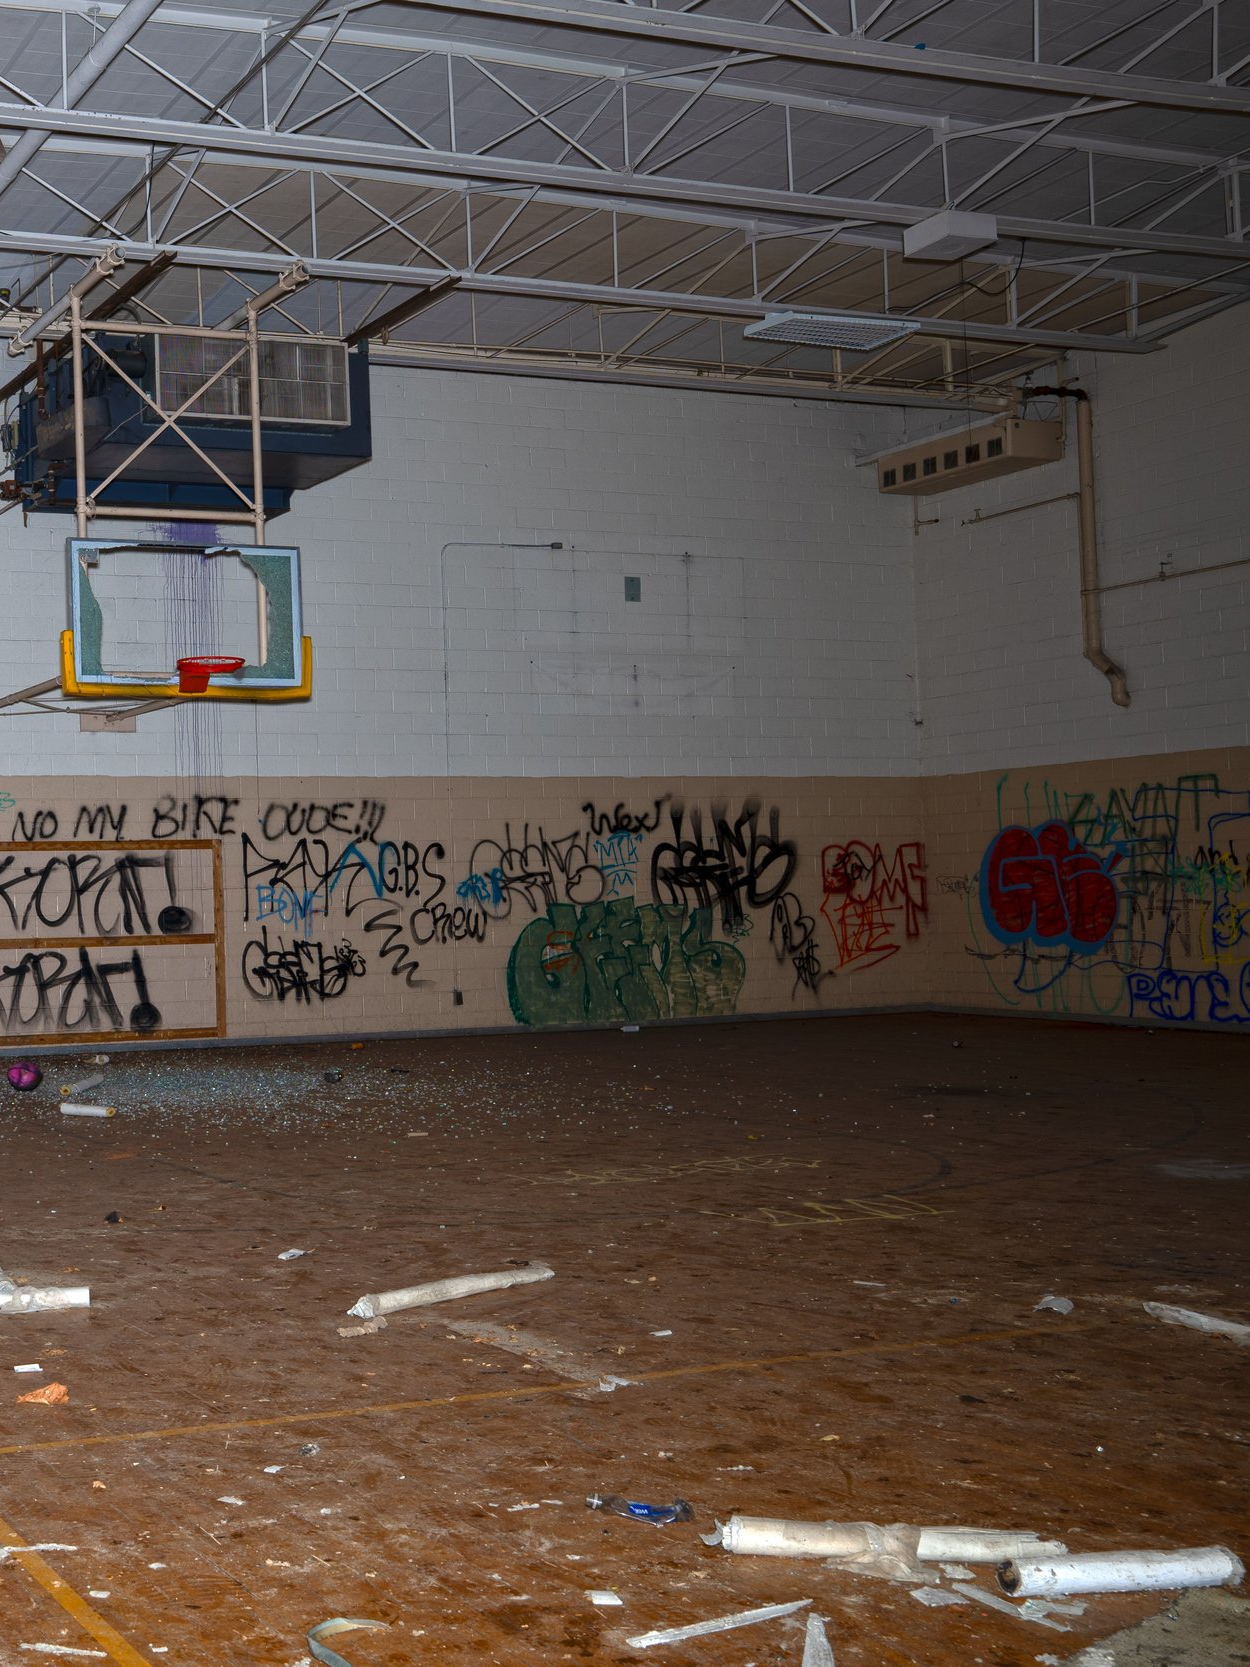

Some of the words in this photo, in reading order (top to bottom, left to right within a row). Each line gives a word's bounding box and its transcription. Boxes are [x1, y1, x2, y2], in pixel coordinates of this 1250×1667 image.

[12, 811, 58, 841] NO
[73, 804, 127, 841] MY
[152, 794, 239, 838] BIKE
